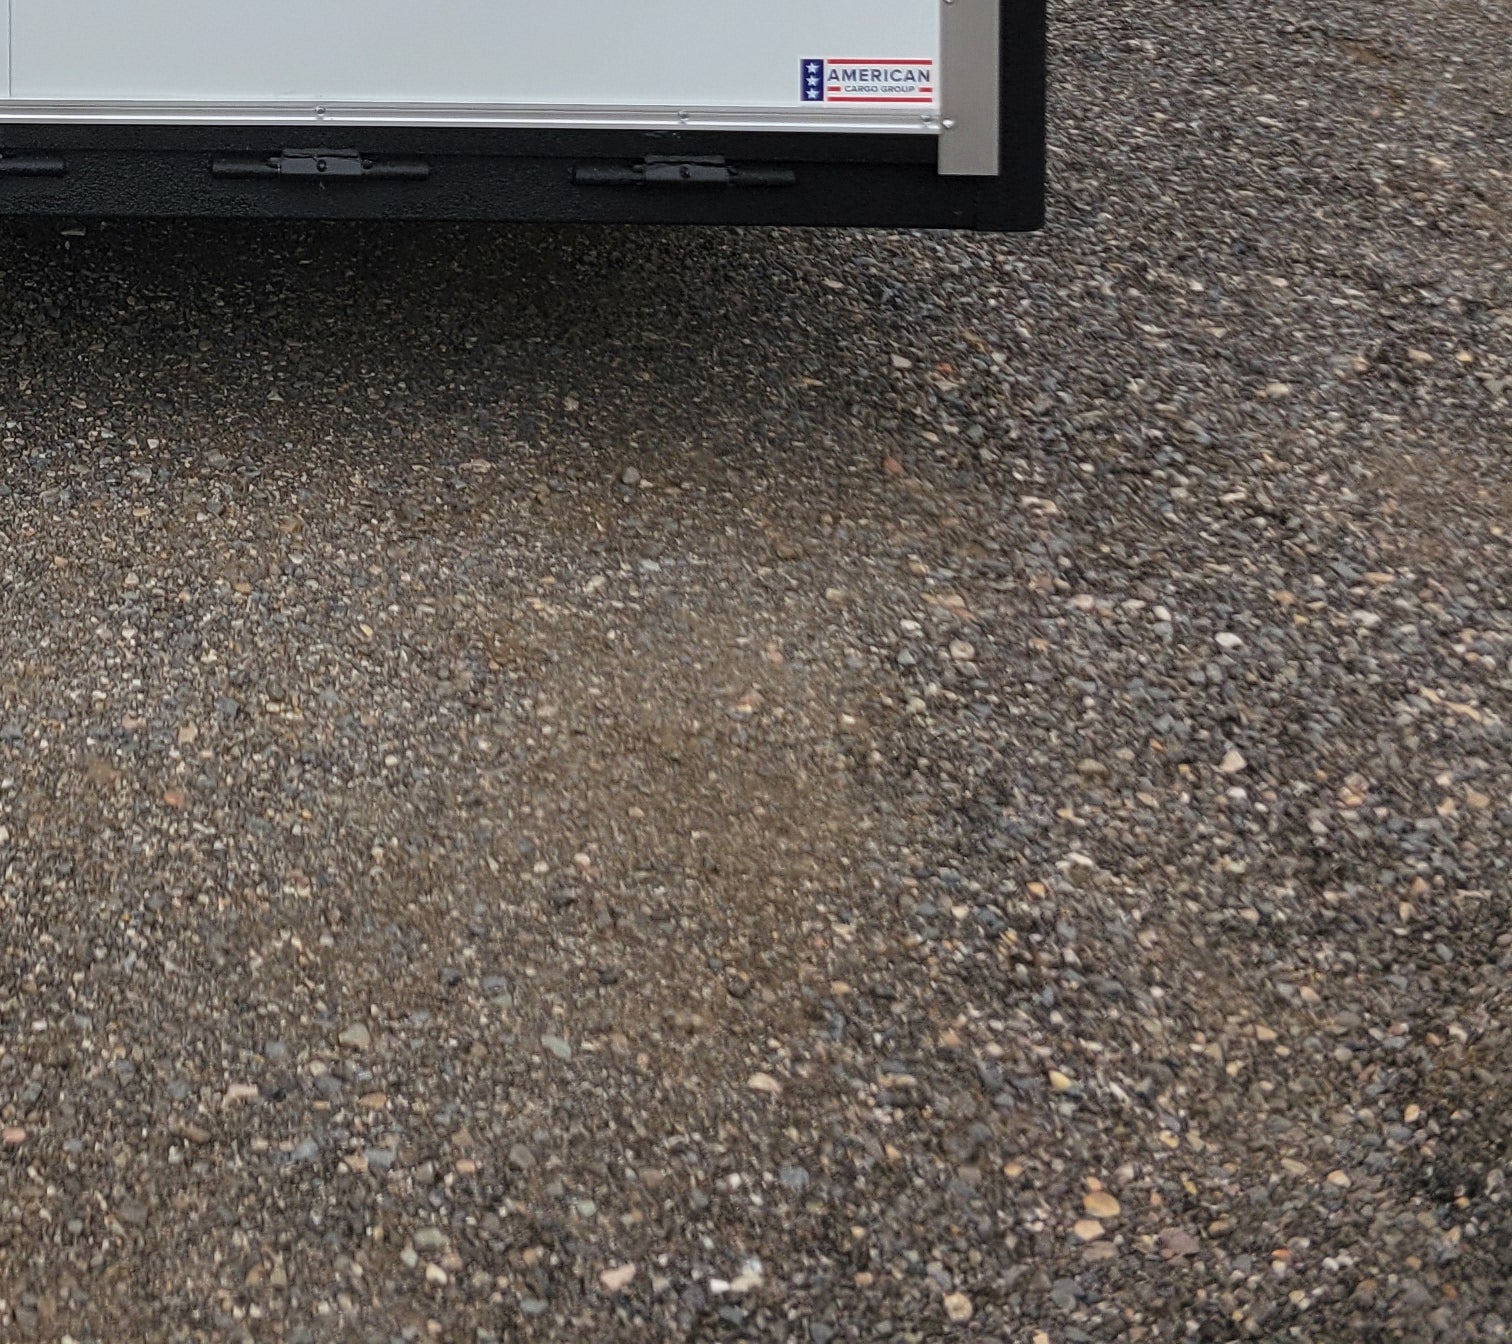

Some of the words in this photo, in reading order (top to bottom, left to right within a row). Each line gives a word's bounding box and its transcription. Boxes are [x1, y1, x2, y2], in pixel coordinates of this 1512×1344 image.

[827, 68, 931, 83] AMERICAN
[844, 85, 878, 93] CARGO
[880, 85, 916, 93] GROUP
